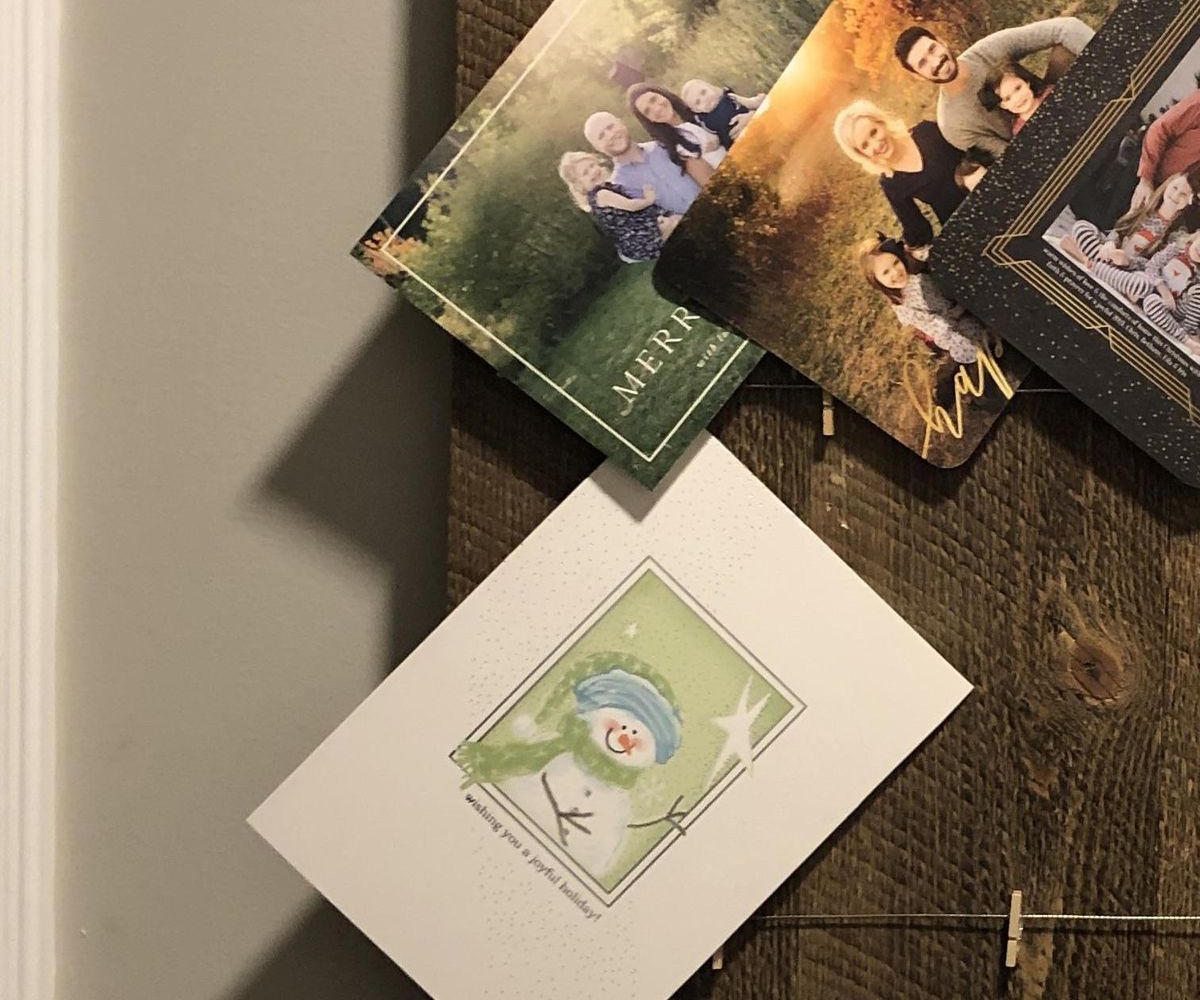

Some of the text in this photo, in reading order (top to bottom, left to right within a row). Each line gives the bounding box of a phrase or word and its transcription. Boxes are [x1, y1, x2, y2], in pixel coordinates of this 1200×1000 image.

[612, 306, 701, 416] MERR
[465, 793, 603, 922] wishing you a joyful holiday!
